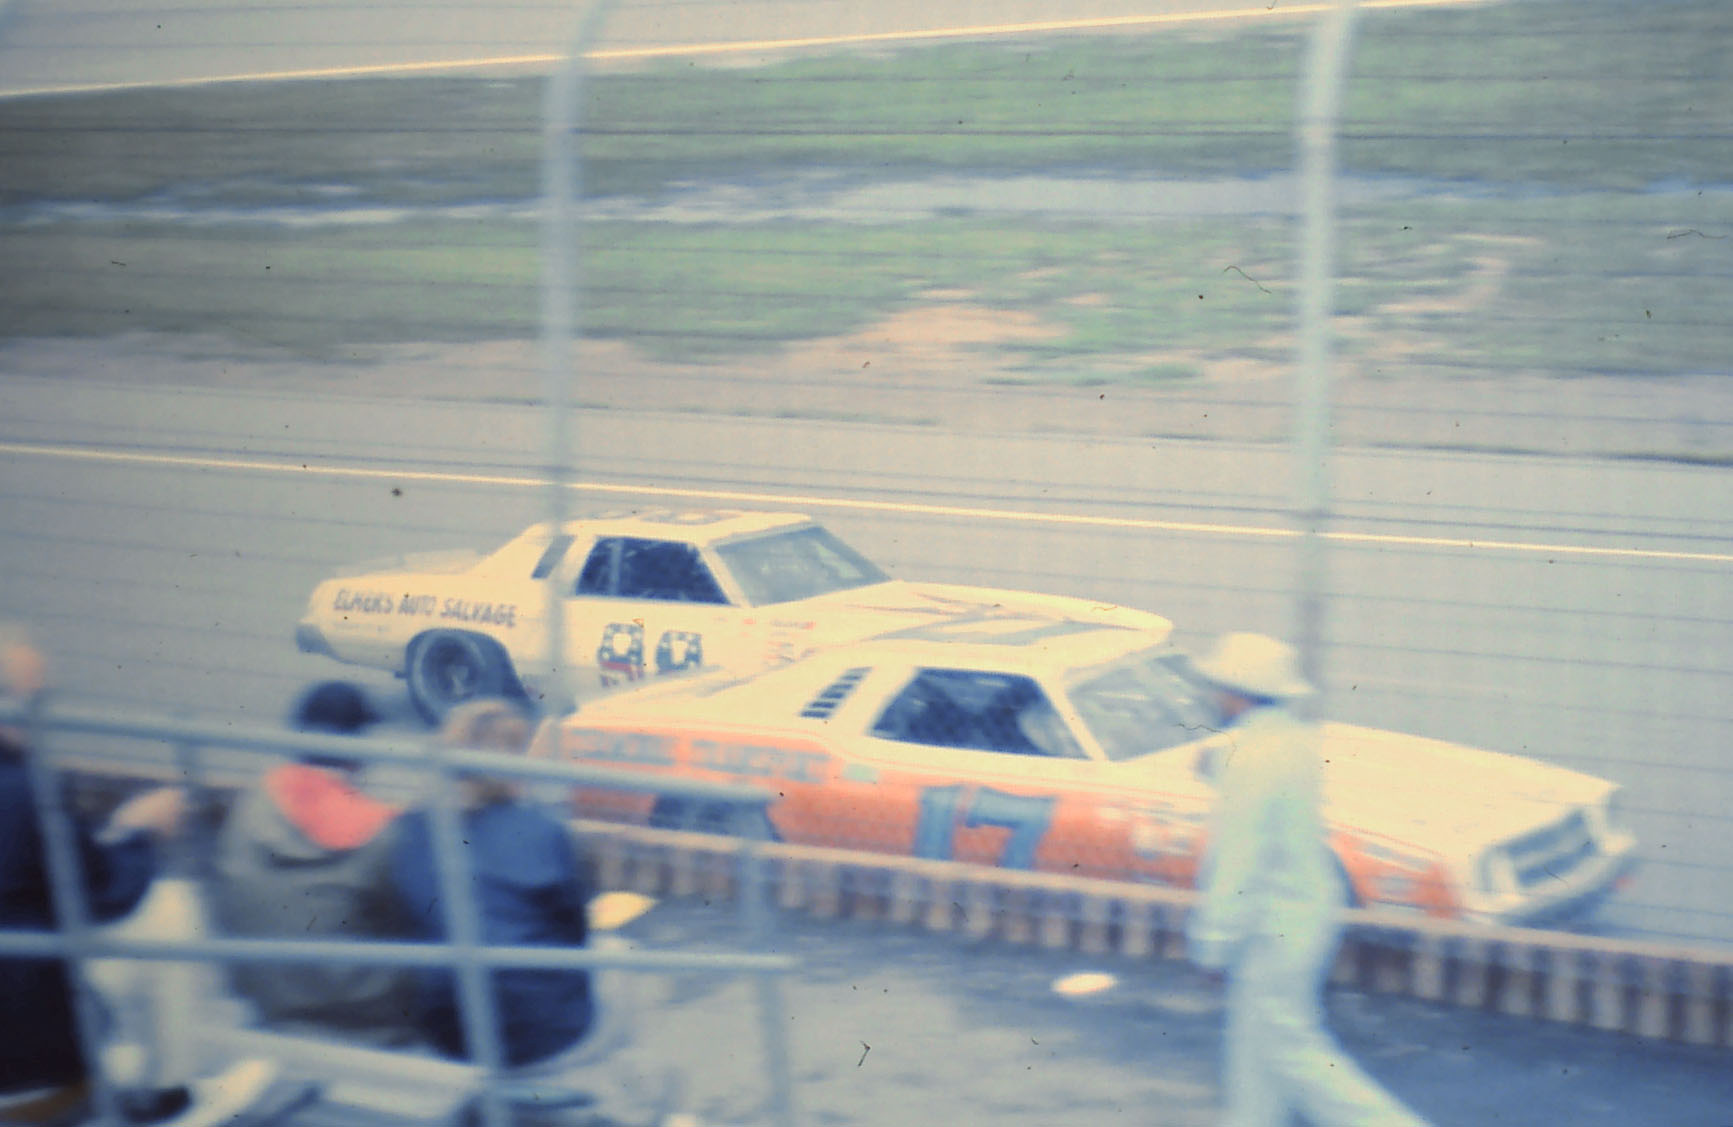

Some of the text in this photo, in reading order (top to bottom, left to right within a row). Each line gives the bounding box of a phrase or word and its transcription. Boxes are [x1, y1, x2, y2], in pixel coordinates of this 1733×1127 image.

[398, 594, 437, 616] AUTO
[440, 598, 517, 628] SALVAGE
[912, 783, 1058, 870] 17
